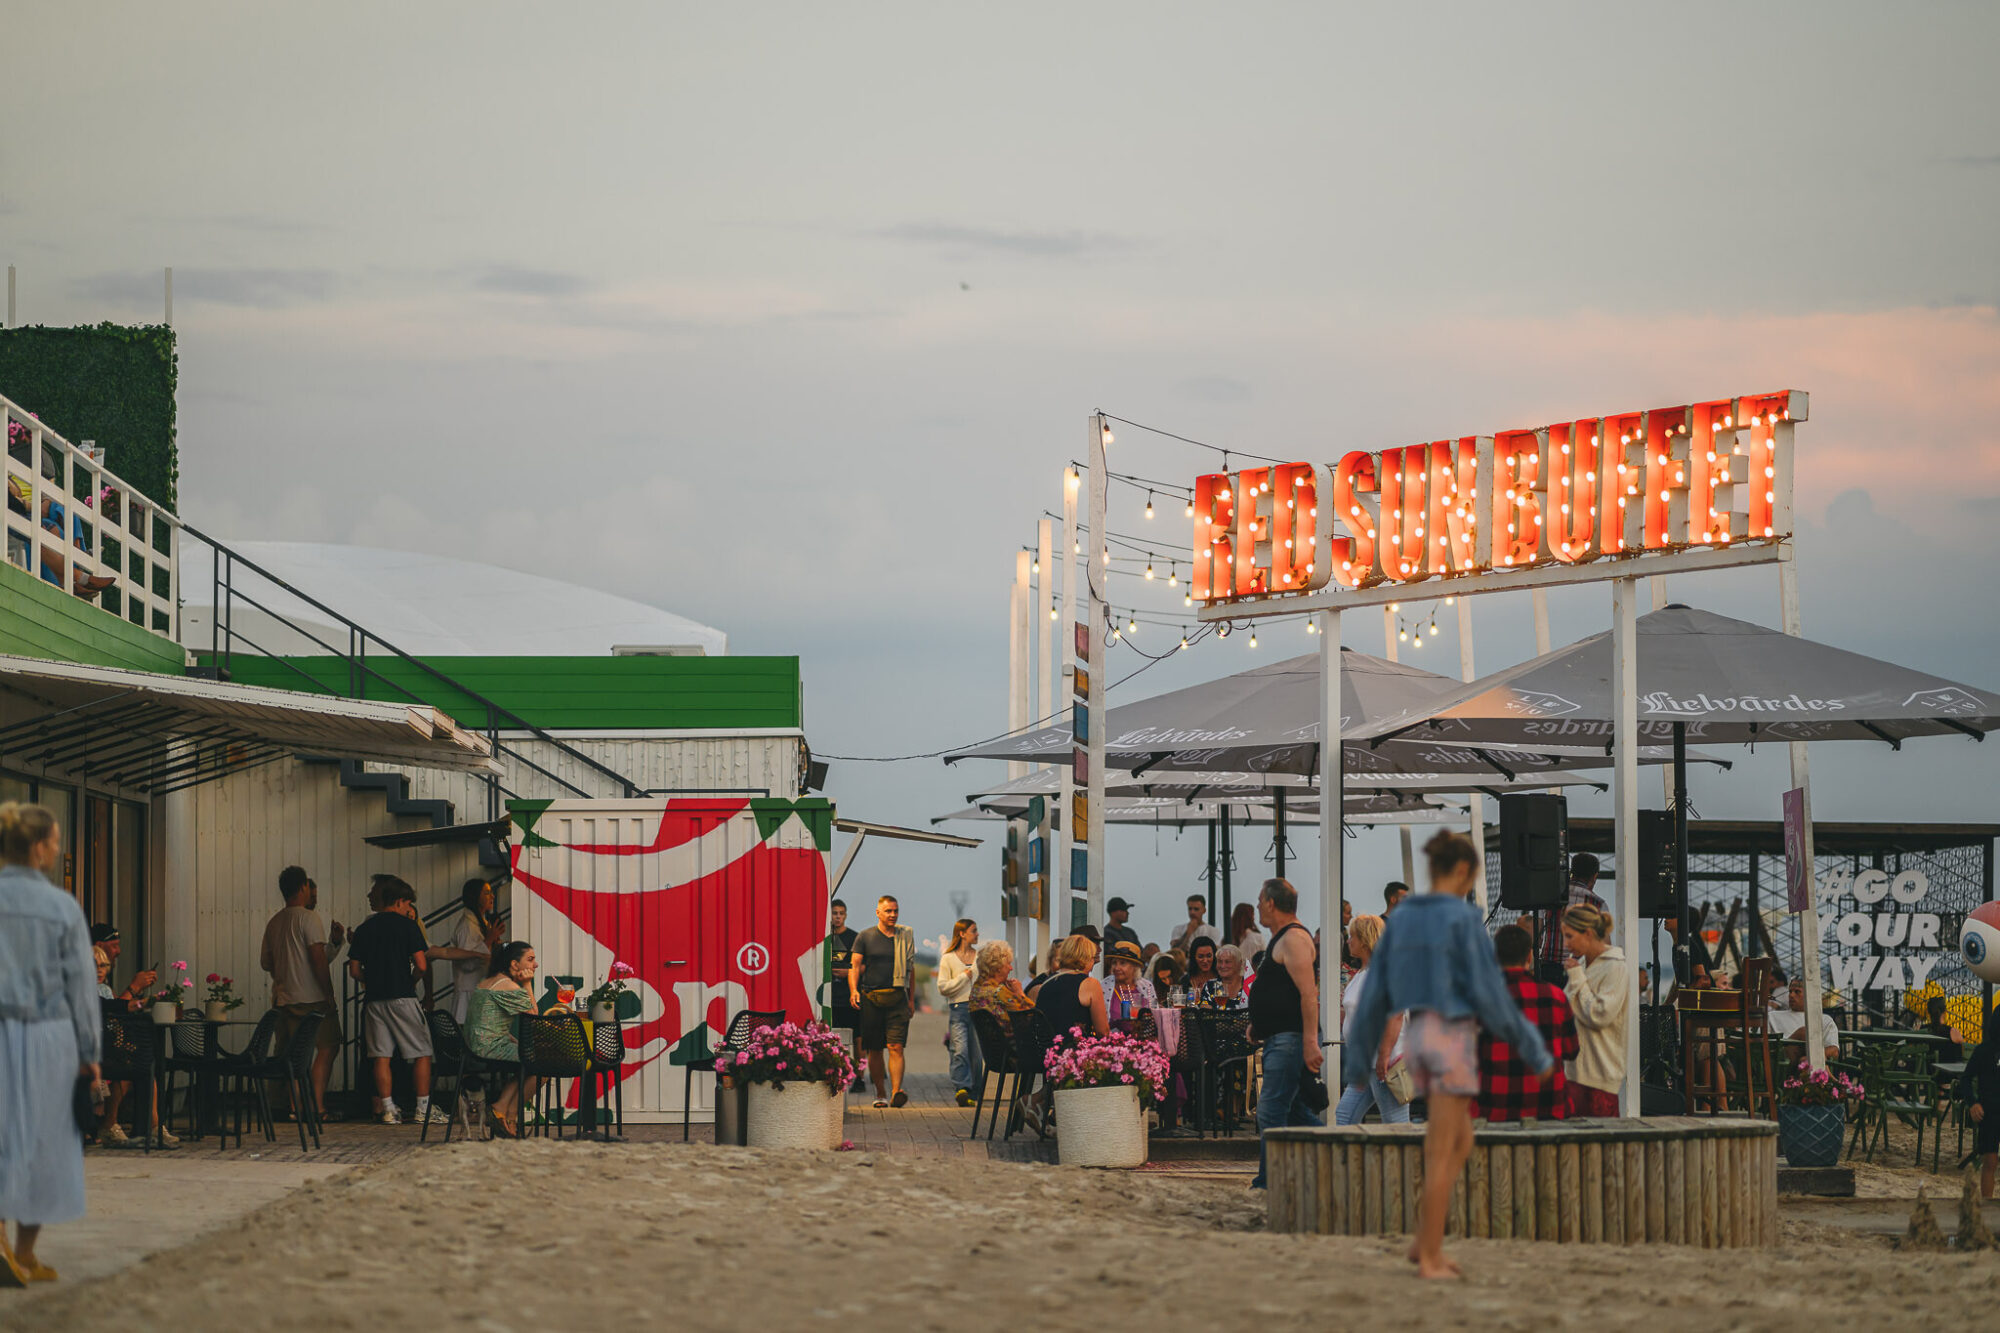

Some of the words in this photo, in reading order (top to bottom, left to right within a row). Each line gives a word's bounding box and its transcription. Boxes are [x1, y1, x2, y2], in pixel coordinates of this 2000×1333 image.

[1191, 462, 1334, 601] RED
[1331, 436, 1494, 589] SUN
[1494, 390, 1809, 569] BUFFET
[1636, 692, 1846, 716] Lielvārdes
[1817, 867, 1929, 904] #GO
[1817, 912, 1941, 949] YOUR
[1829, 956, 1940, 990] WAY
